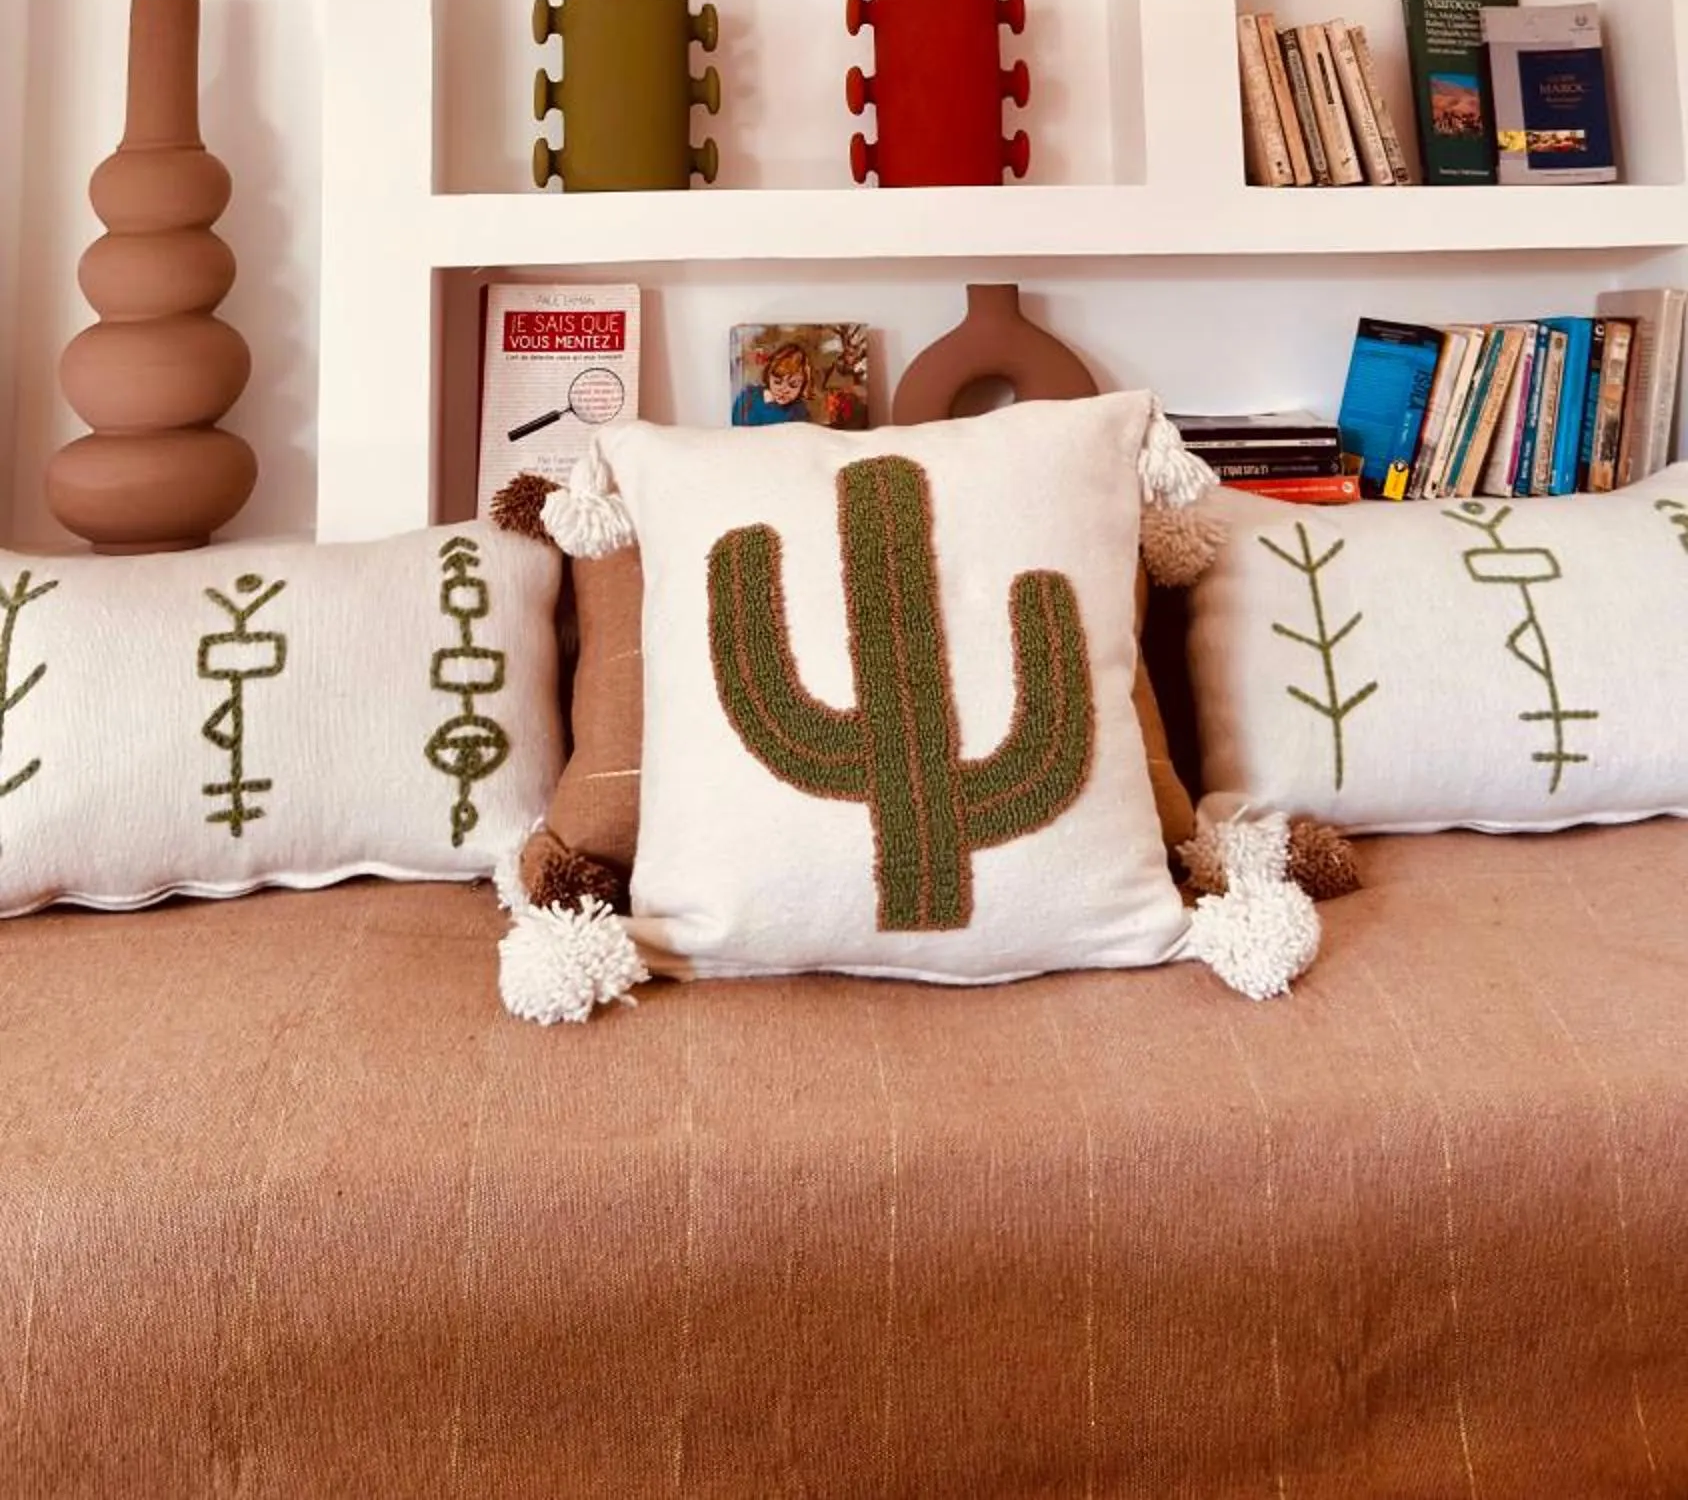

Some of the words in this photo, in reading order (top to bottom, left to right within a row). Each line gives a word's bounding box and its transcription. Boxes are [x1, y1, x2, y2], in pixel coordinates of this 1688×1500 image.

[511, 313, 528, 334] JE
[533, 313, 576, 333] SAIS
[581, 313, 621, 334] QUE
[509, 335, 551, 349] VOUS
[555, 335, 611, 349] MENTEZ
